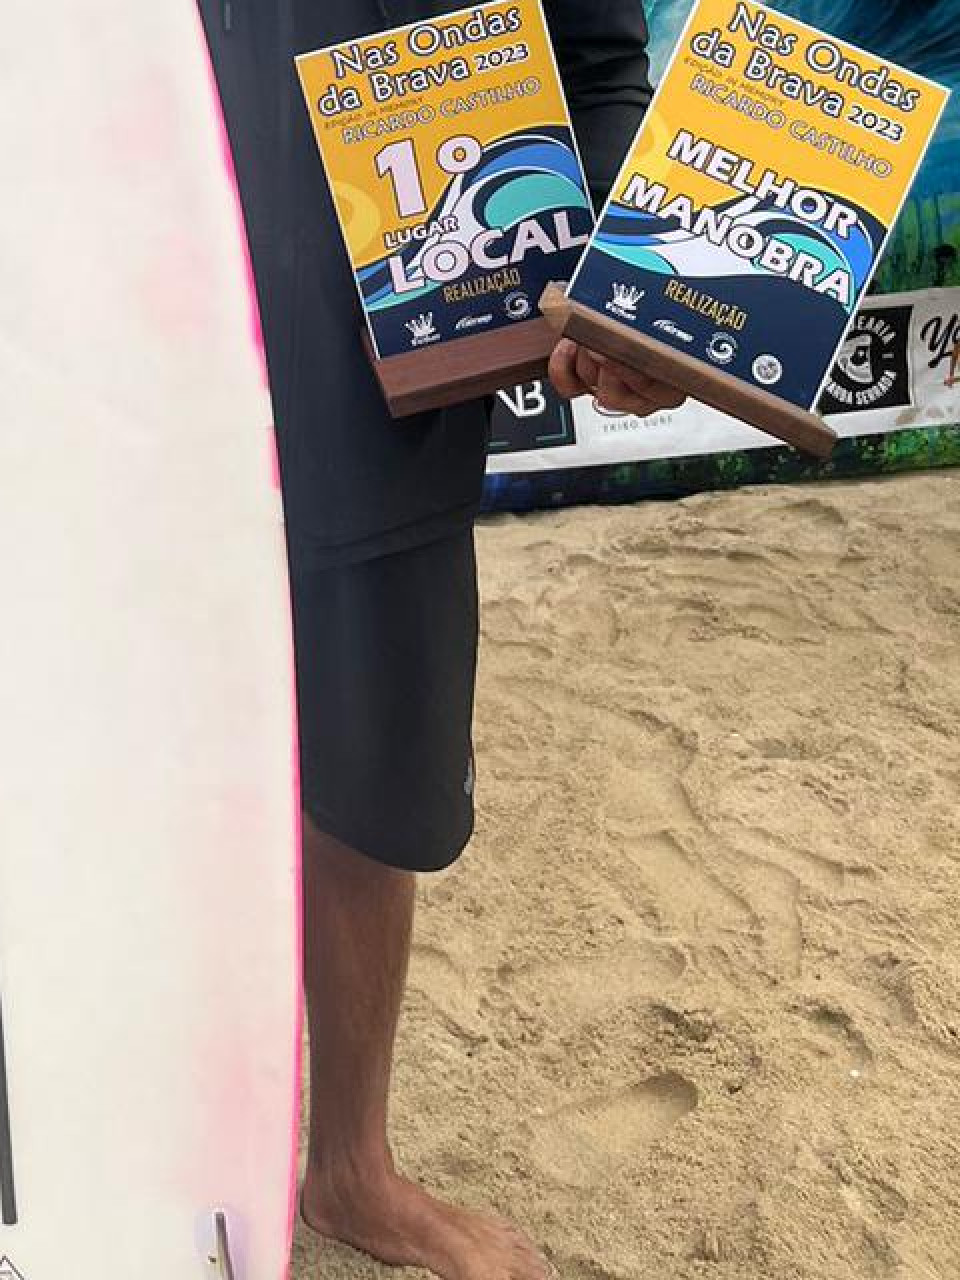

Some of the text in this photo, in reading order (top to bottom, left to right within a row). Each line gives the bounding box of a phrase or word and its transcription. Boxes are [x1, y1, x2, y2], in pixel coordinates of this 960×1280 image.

[318, 43, 530, 117] da Brava 2023
[330, 7, 523, 80] Nas Ondas
[690, 28, 905, 143] da Brava 2023
[729, 1, 921, 112] Nas Ondas
[342, 75, 542, 144] RICARDO CASTILHO
[690, 73, 893, 179] RICARDO CASTILHO
[384, 214, 461, 249] LUGAR
[667, 128, 862, 241] MELHOR
[390, 210, 590, 293] LOCAL
[620, 172, 854, 303] MANOBRA
